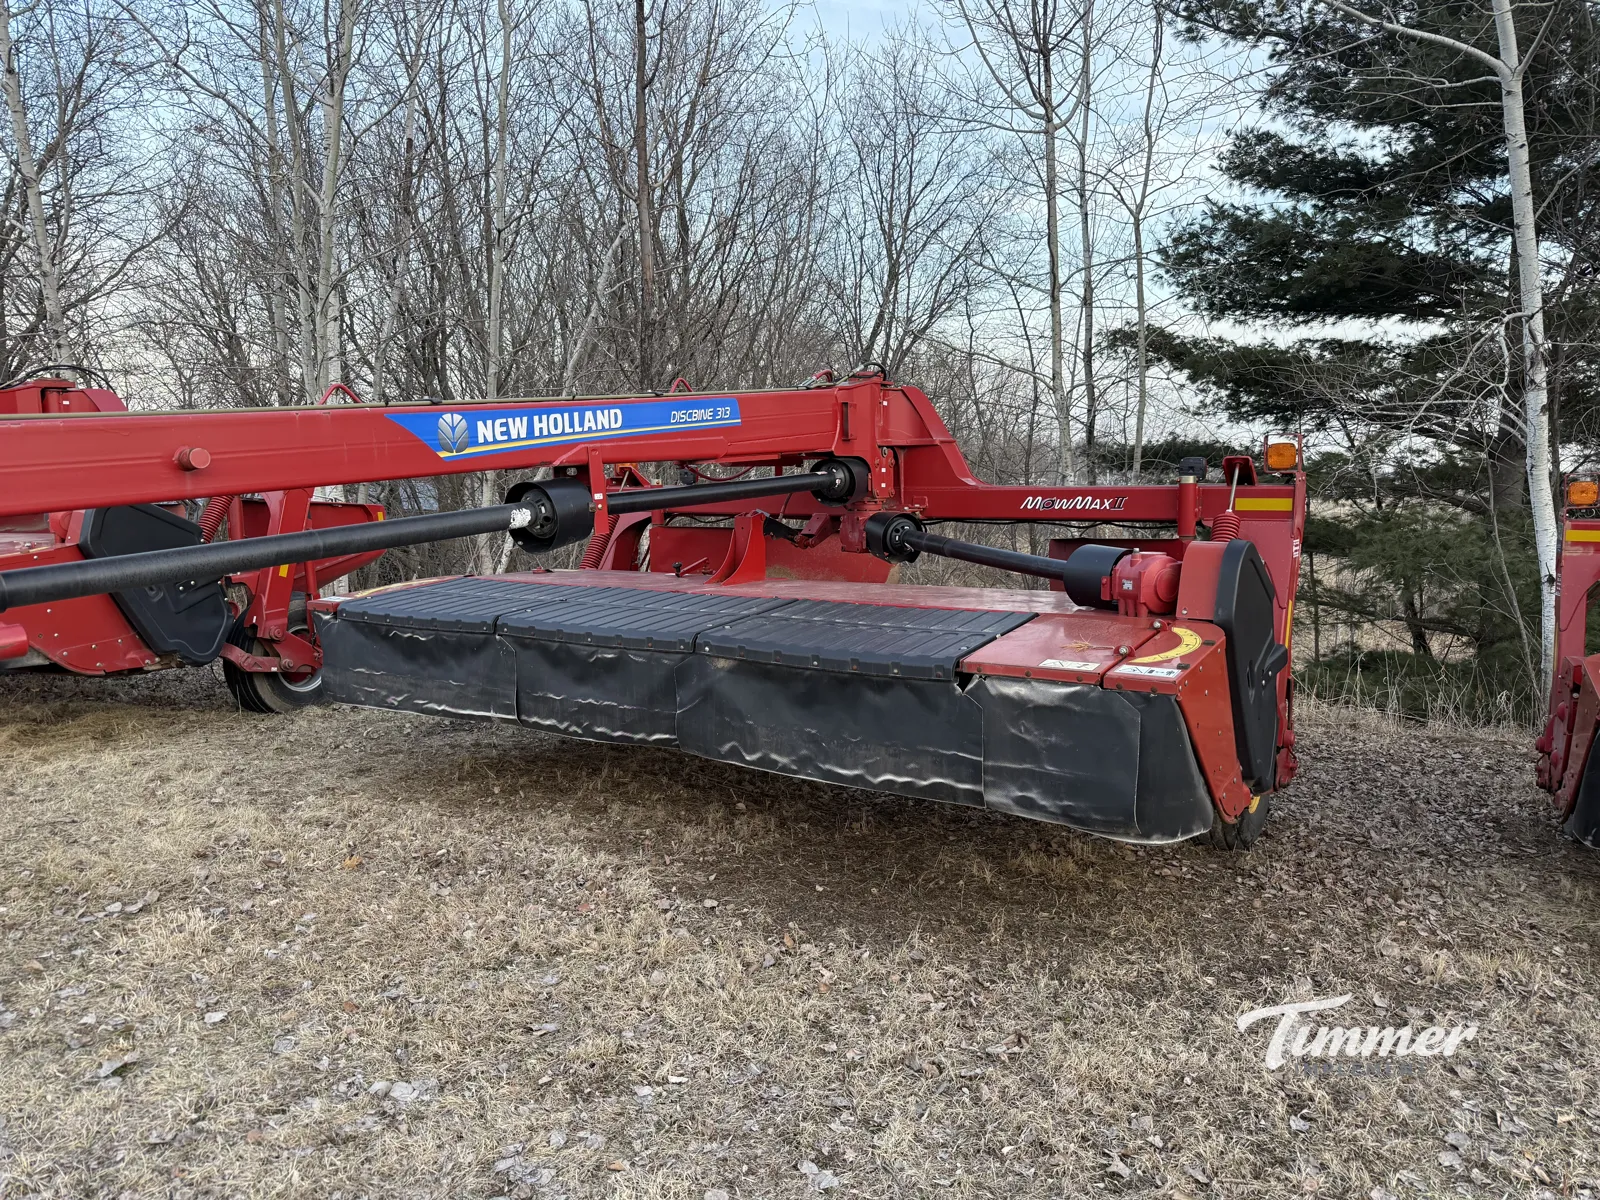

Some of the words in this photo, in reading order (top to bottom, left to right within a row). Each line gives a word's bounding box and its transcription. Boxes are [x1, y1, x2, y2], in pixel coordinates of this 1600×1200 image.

[476, 416, 528, 444] NEW
[533, 408, 623, 437] HOLLAND
[670, 408, 714, 423] DISCBINE
[715, 406, 731, 419] 313
